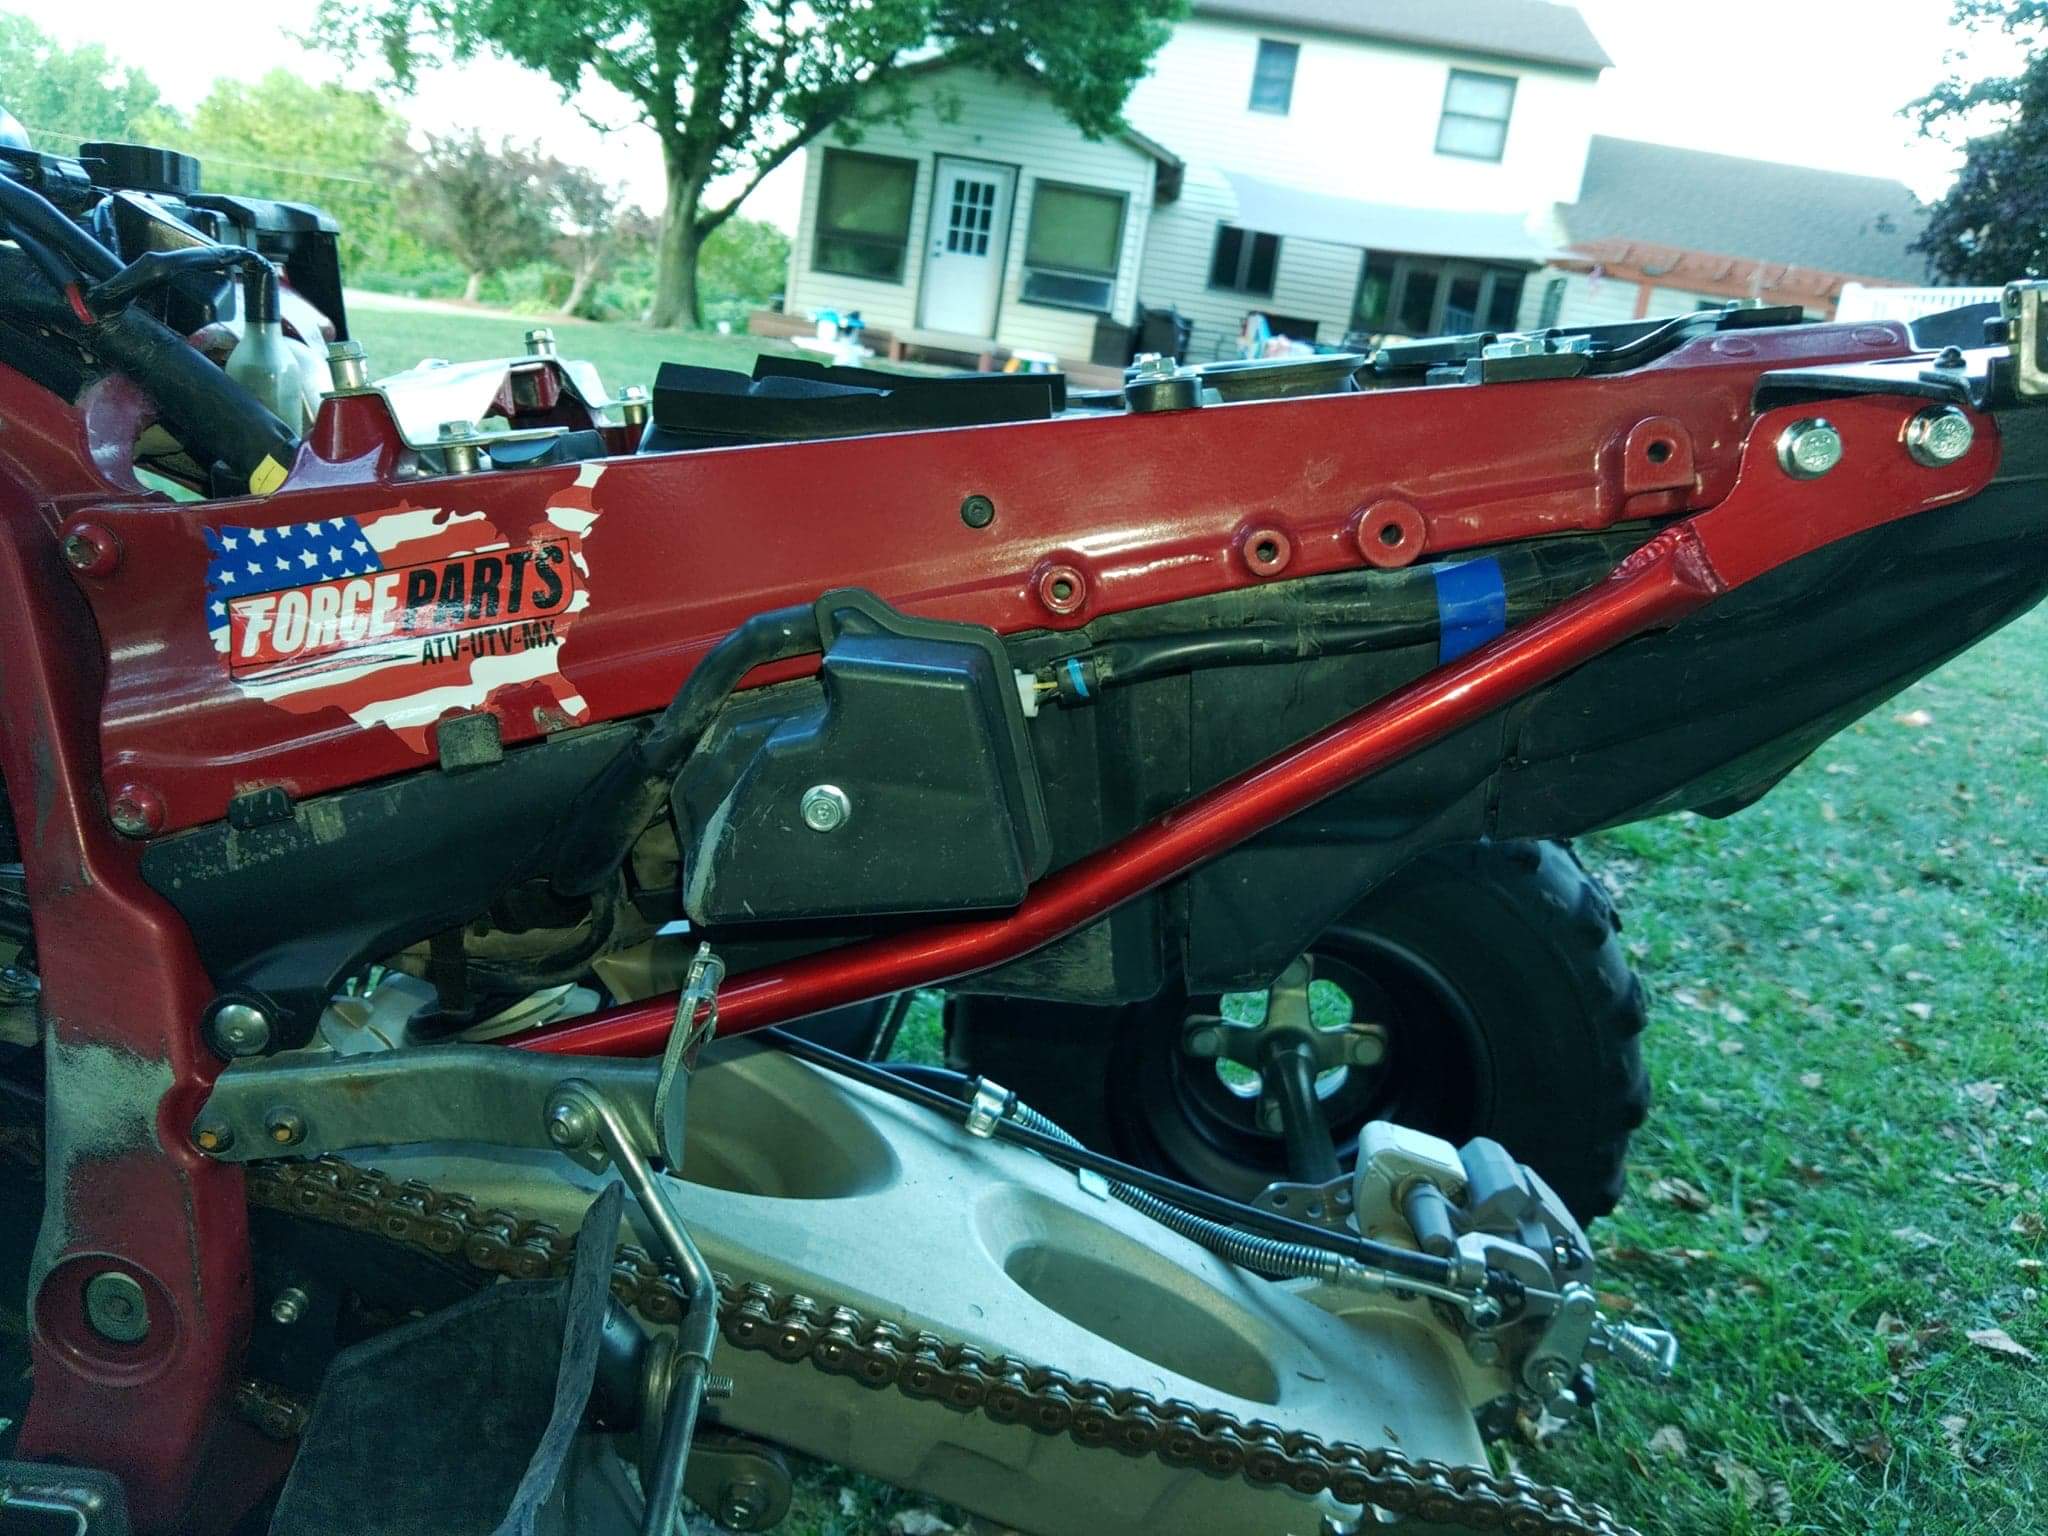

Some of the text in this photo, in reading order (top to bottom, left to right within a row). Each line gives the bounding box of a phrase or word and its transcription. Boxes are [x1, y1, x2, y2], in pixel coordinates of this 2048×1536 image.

[231, 545, 564, 658] FORCE PARTS
[421, 619, 559, 666] ATV-UTV-MX
